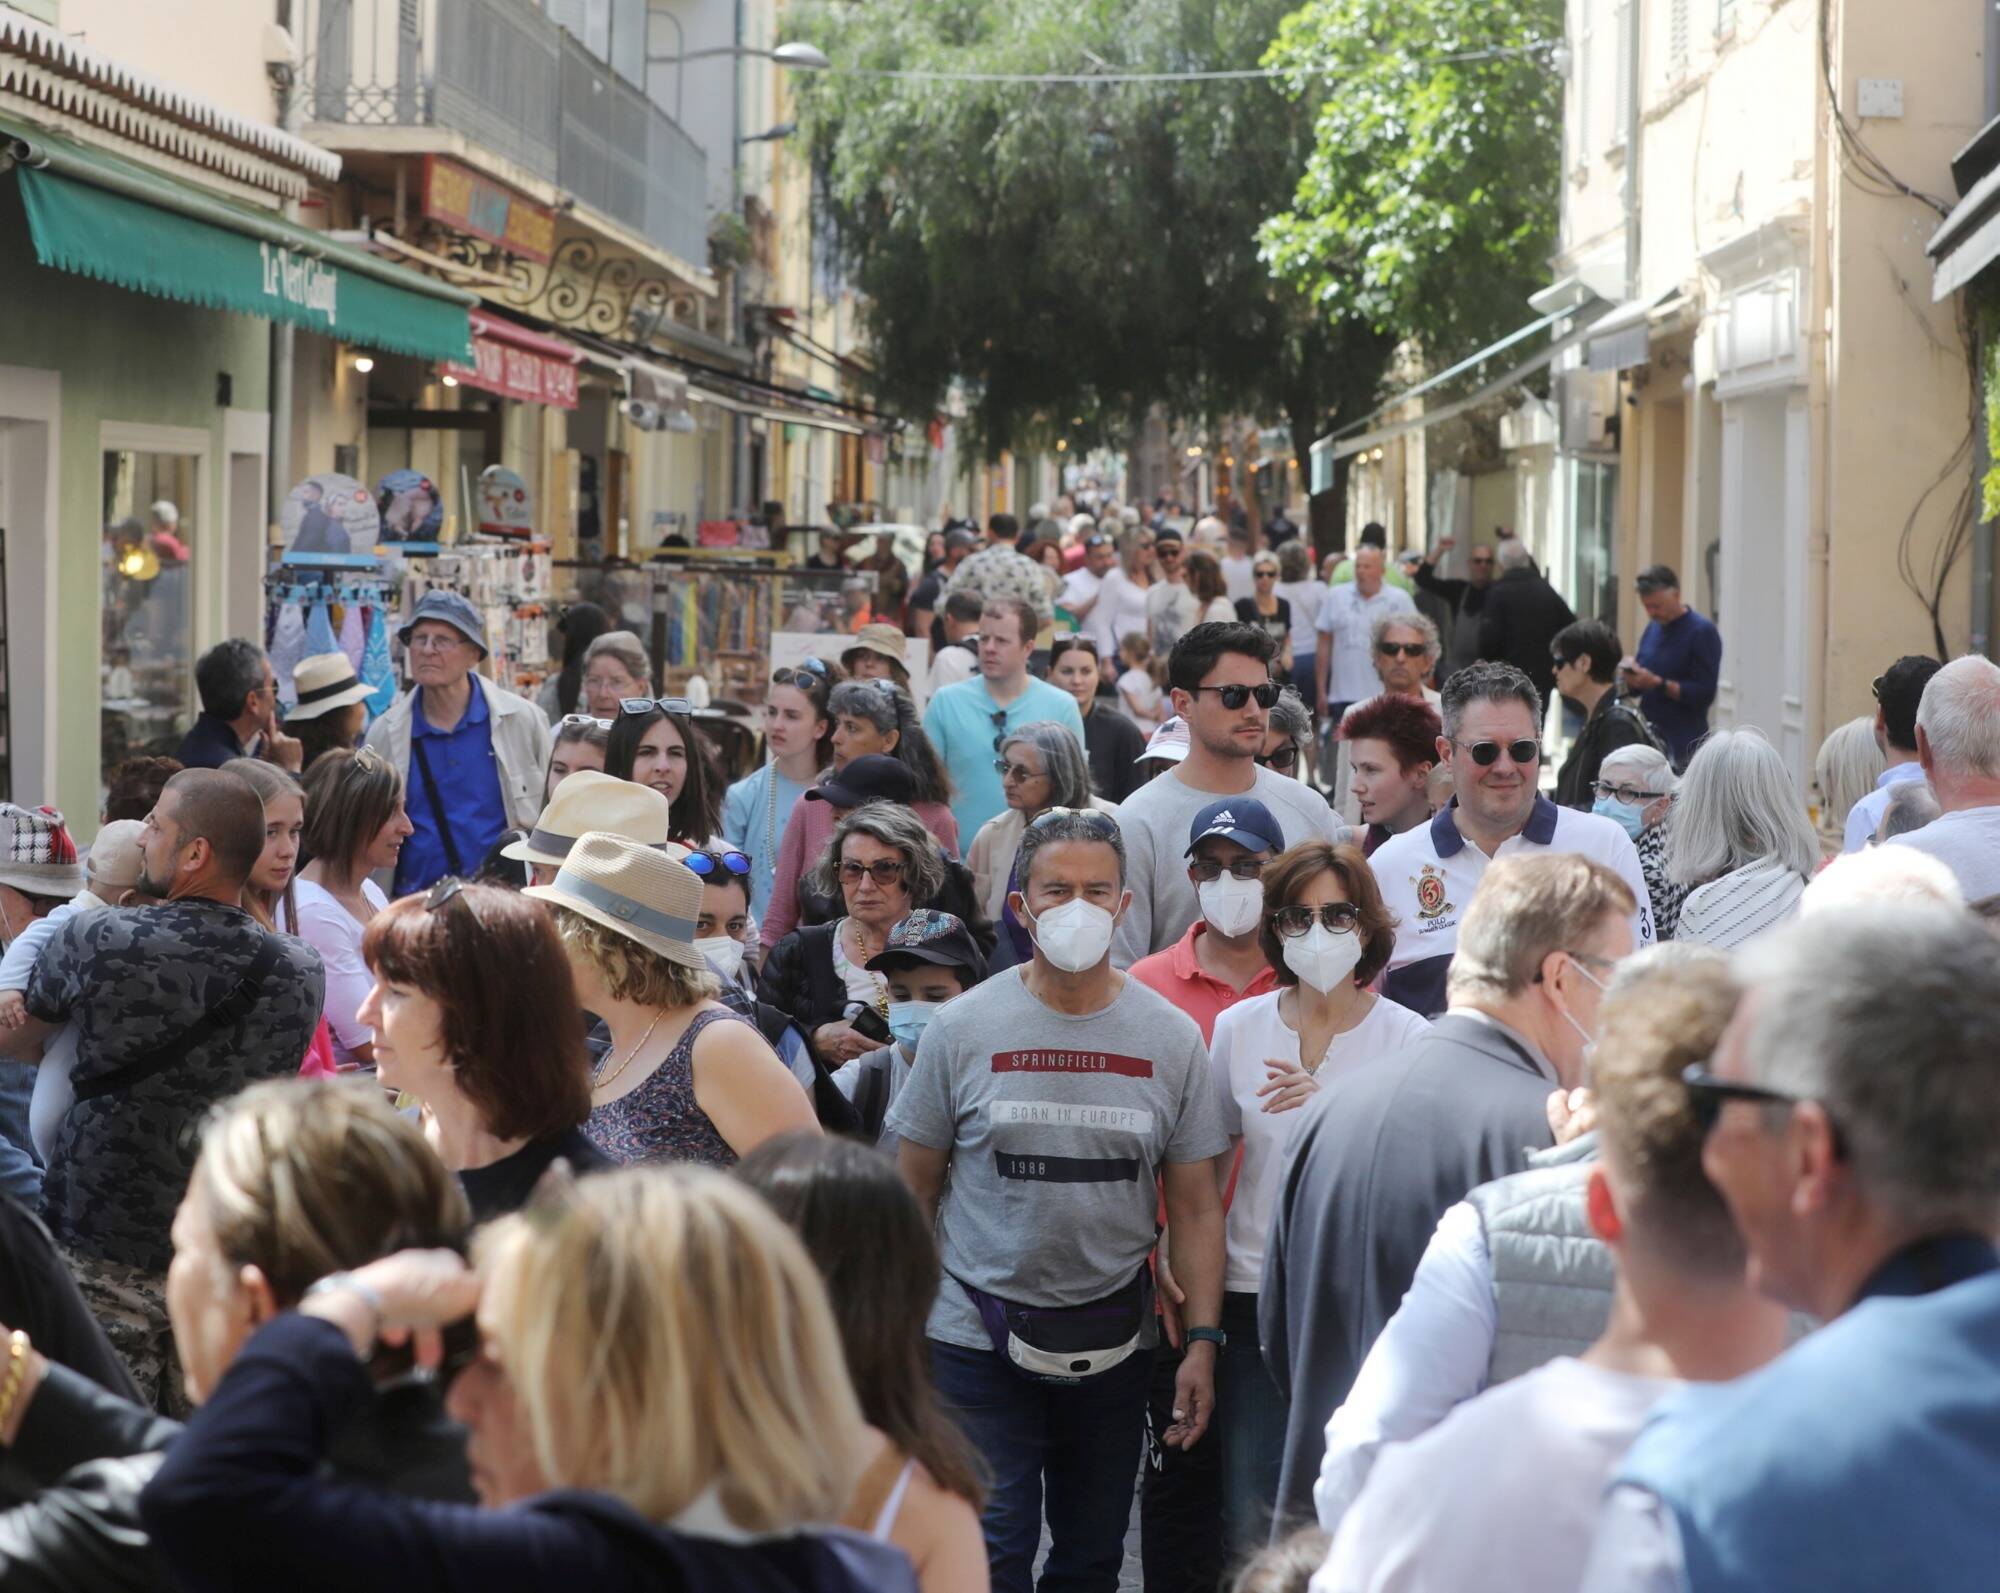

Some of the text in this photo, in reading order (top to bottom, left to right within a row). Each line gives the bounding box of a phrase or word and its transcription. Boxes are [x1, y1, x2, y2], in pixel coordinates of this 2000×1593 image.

[260, 241, 278, 296] Le
[1427, 916, 1446, 927] POLO
[1639, 906, 1651, 939] 3
[1011, 1054, 1107, 1069] SPRINGFIELD
[1010, 1106, 1137, 1126] BORN IN EUROPE
[1010, 1160, 1047, 1175] 1988
